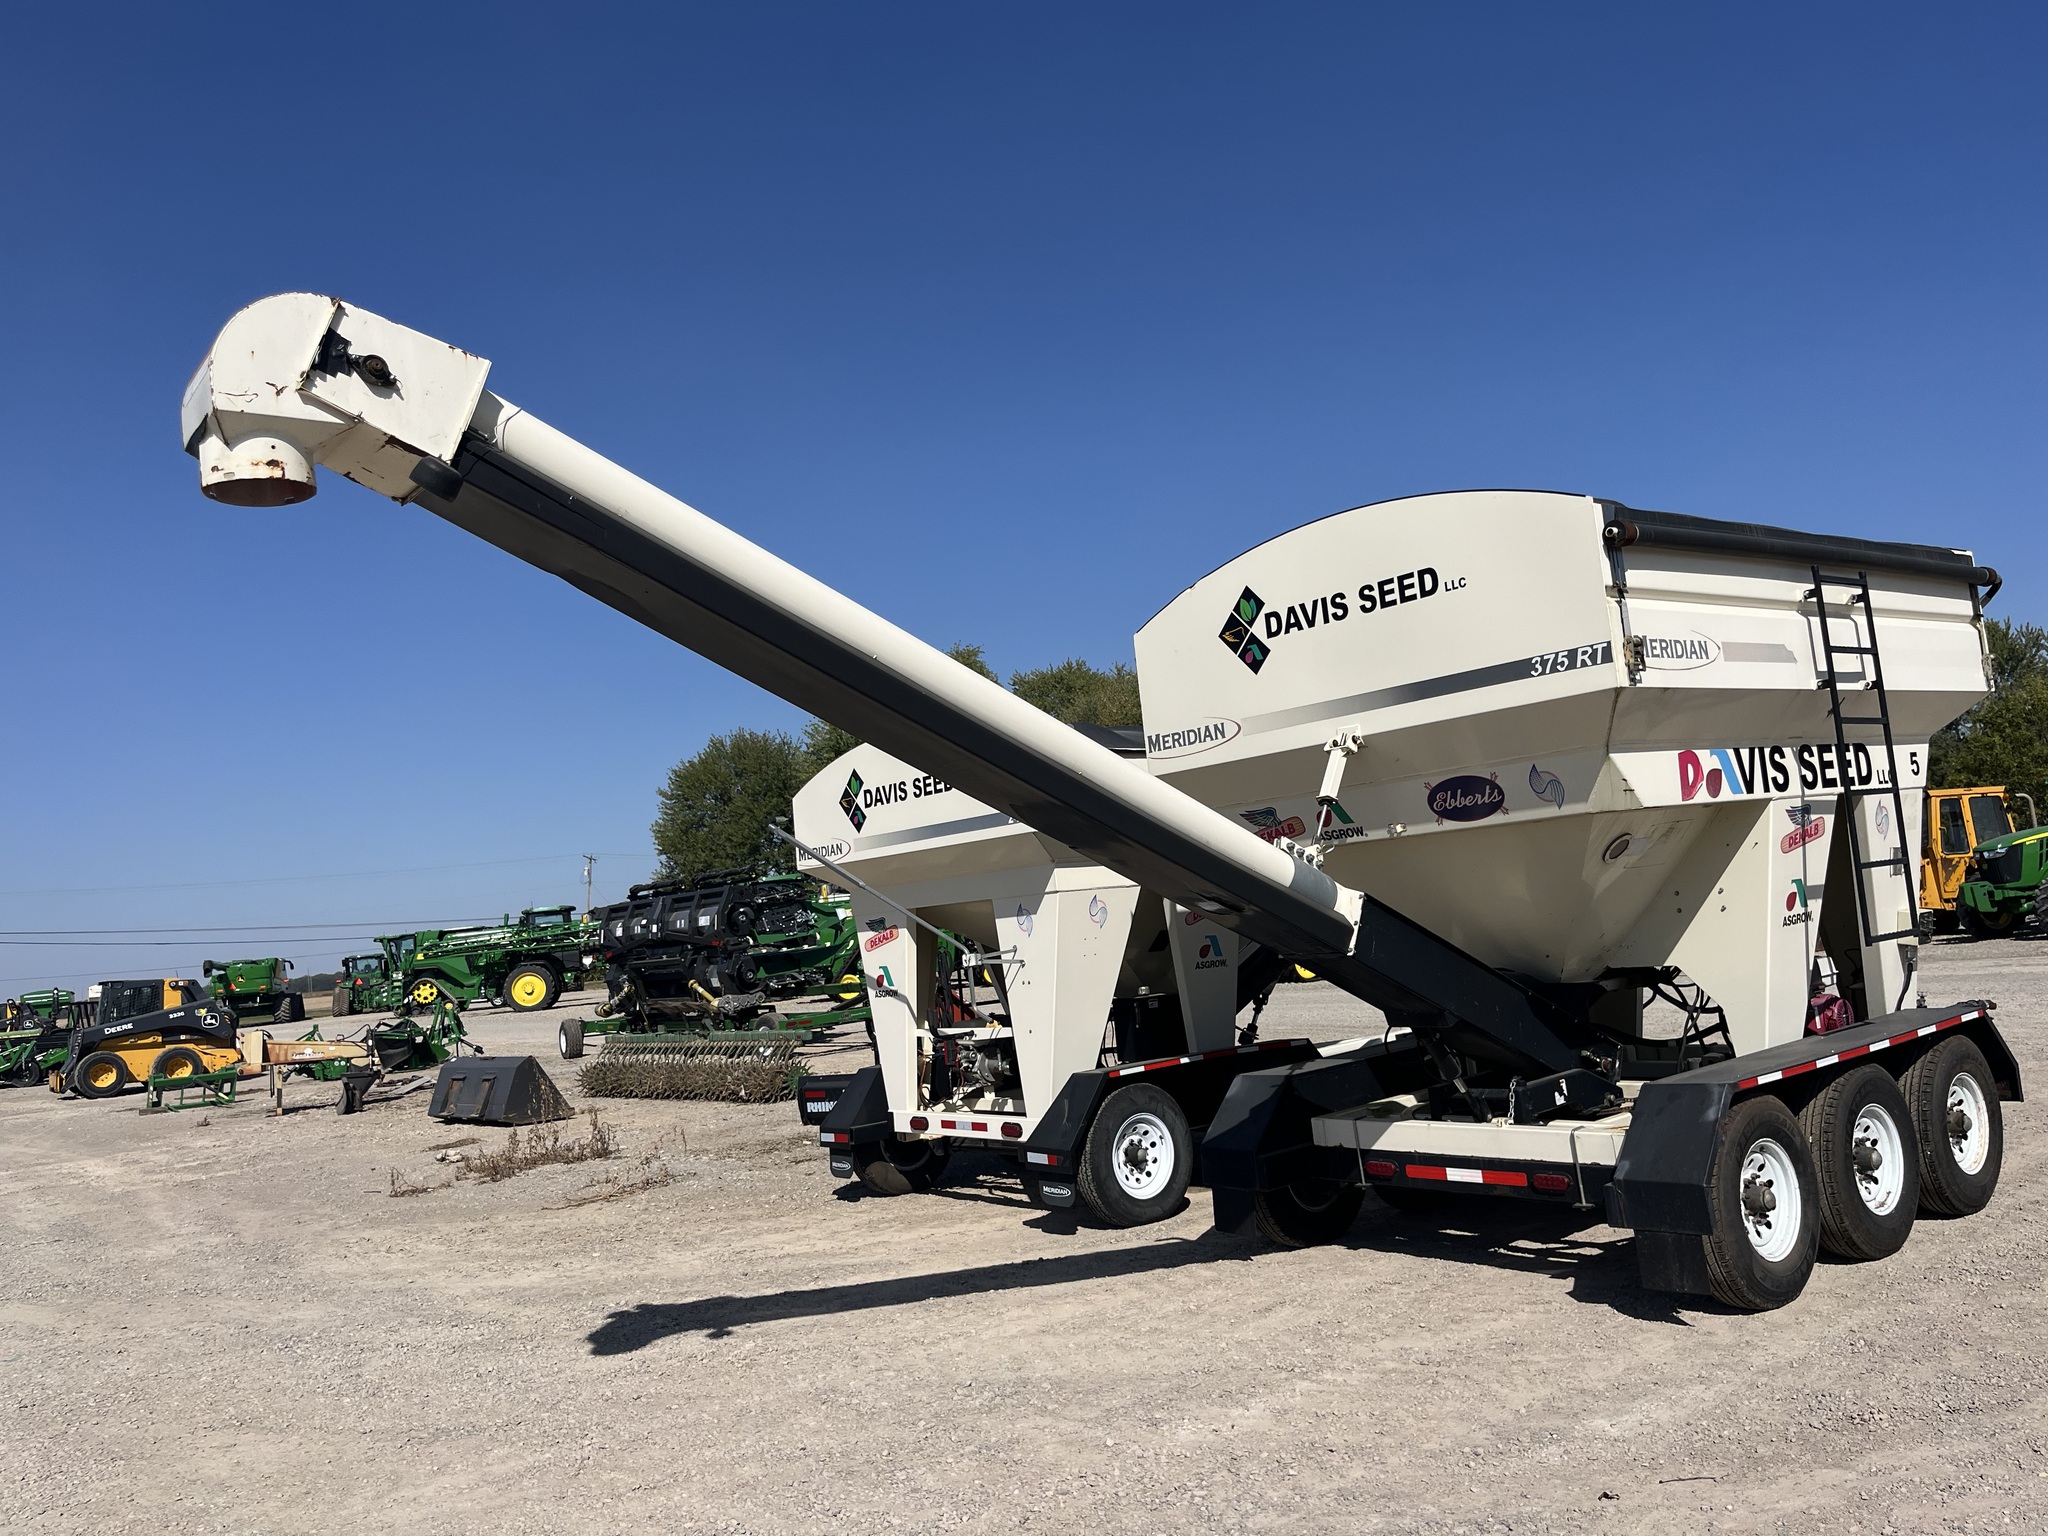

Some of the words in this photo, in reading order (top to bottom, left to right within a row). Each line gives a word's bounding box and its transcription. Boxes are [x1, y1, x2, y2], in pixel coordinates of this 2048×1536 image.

[1264, 592, 1349, 639] DAVIS
[1358, 567, 1439, 614] SEED
[1444, 577, 1467, 593] LLC
[1530, 650, 1569, 677] 375
[1576, 642, 1608, 668] RT
[1147, 722, 1226, 754] MERIDIAN
[1678, 746, 1790, 801] DAVIS
[1799, 742, 1873, 790] SEED
[1909, 751, 1920, 776] 5
[863, 780, 908, 809] DAVIS
[1433, 785, 1503, 812] Ebberts
[1788, 823, 1820, 849] DEKALB
[1782, 911, 1814, 927] ASGROW
[870, 929, 894, 949] DEKALB
[1195, 959, 1227, 970] ASGROW
[104, 1023, 134, 1035] DEERE
